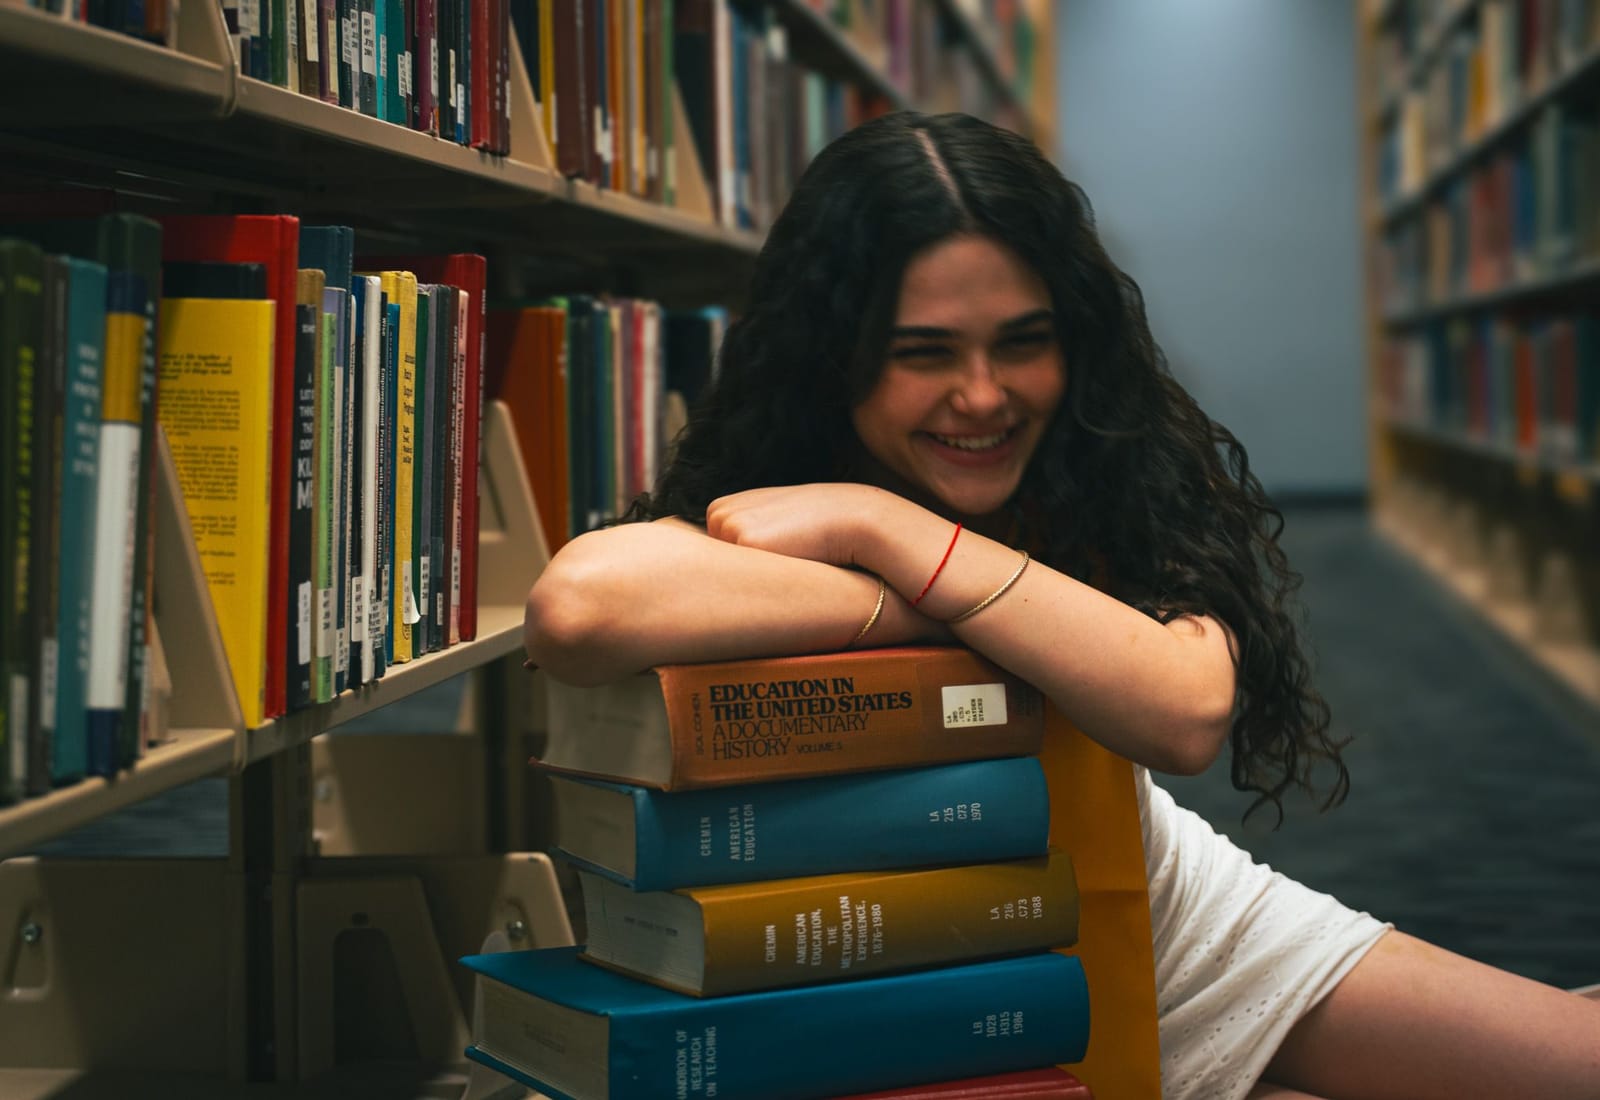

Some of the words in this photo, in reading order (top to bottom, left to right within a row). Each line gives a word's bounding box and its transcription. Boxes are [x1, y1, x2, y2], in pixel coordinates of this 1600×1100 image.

[709, 678, 828, 702] EDUCATION
[832, 677, 854, 695] IN
[709, 702, 754, 721] THE
[757, 697, 836, 719] UNITED
[838, 691, 912, 713] STATES
[712, 723, 727, 741] A
[728, 713, 870, 740] DOCUMENTARY
[946, 715, 952, 724] LA
[713, 737, 791, 761] HISTORY
[929, 810, 940, 822] LA
[943, 807, 954, 822] 215
[957, 804, 967, 820] C73
[970, 802, 982, 821] 1970
[700, 816, 711, 856] CREMIN
[728, 807, 741, 860] AMERICAN
[743, 804, 756, 862] EDUCATION
[989, 907, 1000, 920] LA
[1003, 903, 1014, 919] 216
[1018, 898, 1028, 919] .C73
[1032, 896, 1042, 919] 1988
[795, 913, 807, 964] AMERICAN
[810, 908, 822, 966] EDUCATION,
[827, 926, 838, 945] THE
[839, 895, 853, 969] METROPOLITAN
[871, 903, 883, 954] 1876-1980
[765, 924, 776, 962] CREMIN
[973, 1021, 983, 1034] LB
[986, 1014, 997, 1038] 1028
[1013, 1011, 1023, 1034] 1986
[675, 1029, 687, 1042] OF
[705, 1026, 717, 1077] TEACHING
[691, 1037, 702, 1091] RESEARCH
[706, 1082, 717, 1097] ON
